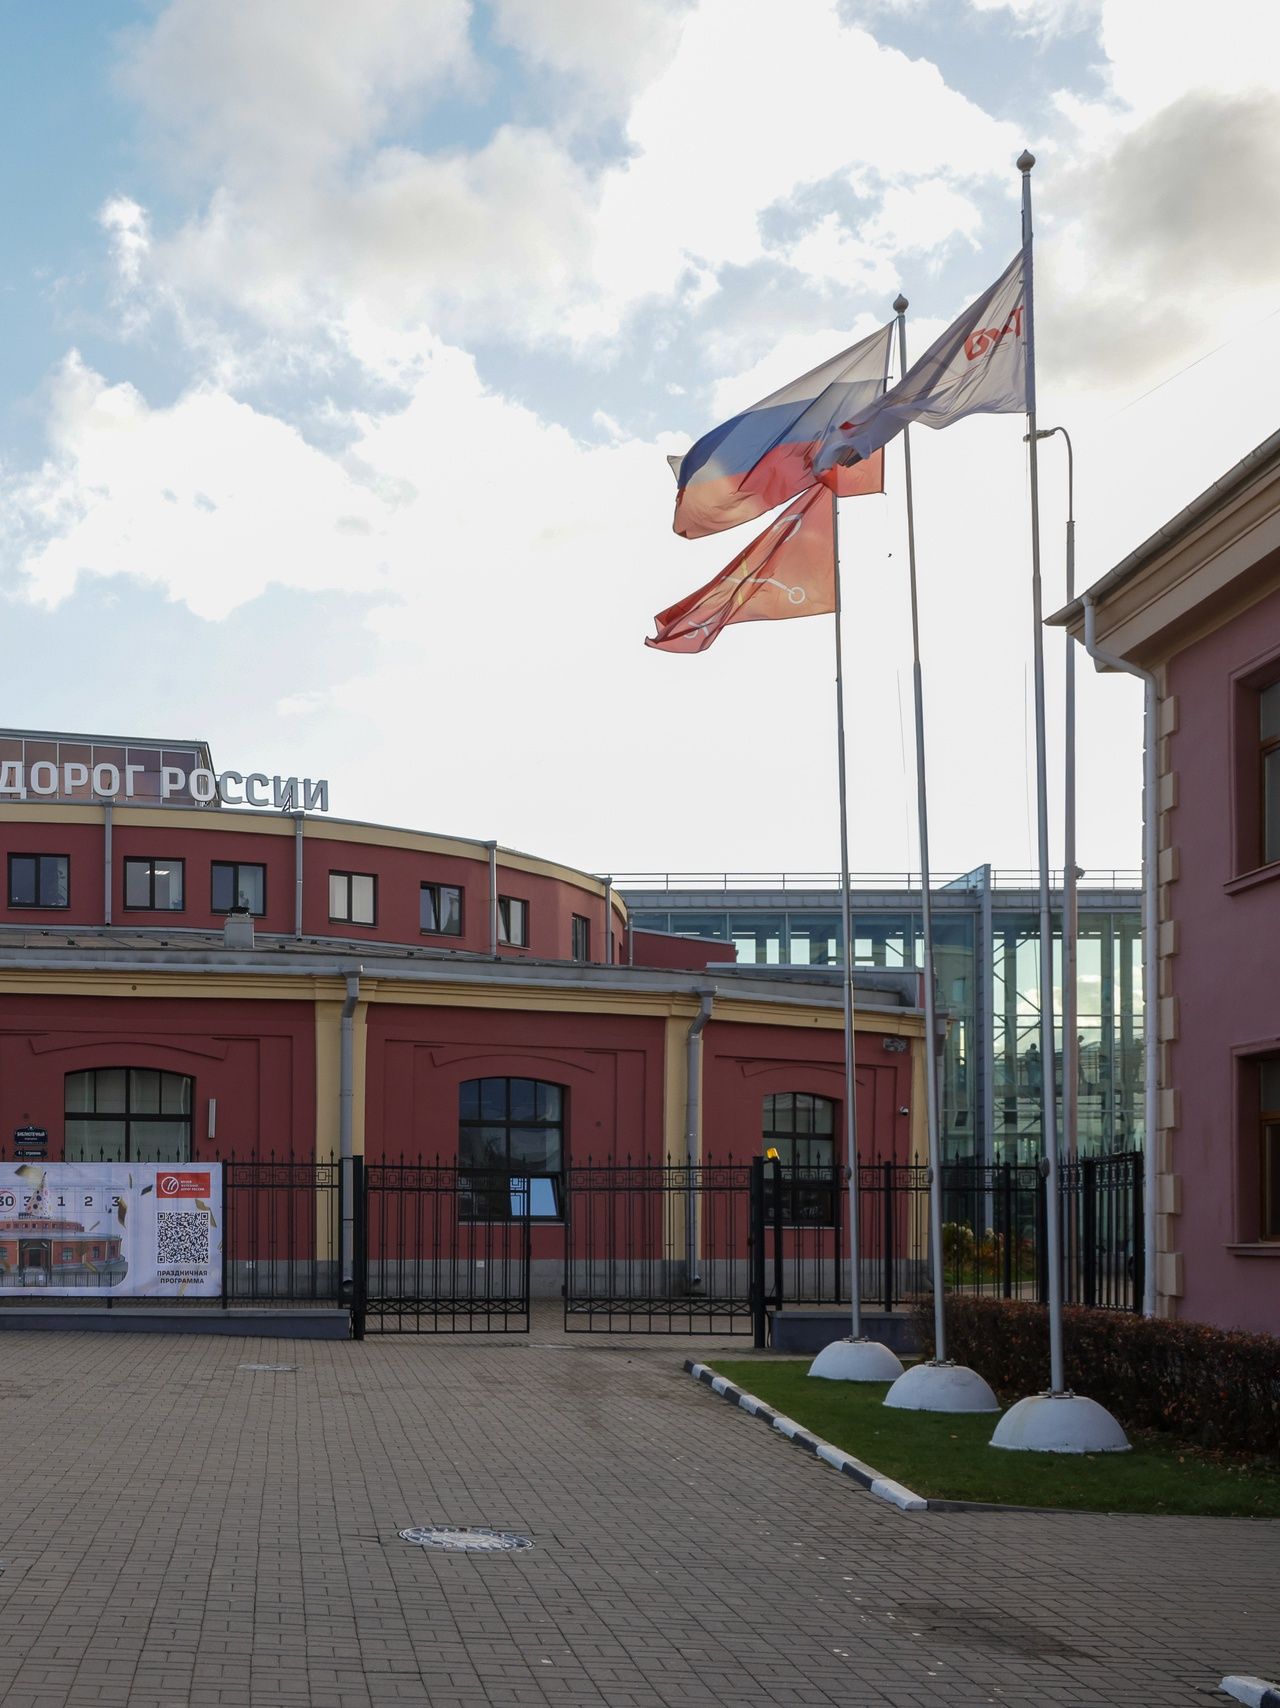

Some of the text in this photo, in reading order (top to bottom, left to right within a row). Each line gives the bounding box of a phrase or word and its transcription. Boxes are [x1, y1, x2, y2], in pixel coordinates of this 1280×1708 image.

[162, 766, 329, 812] РОССИИ
[57, 1196, 66, 1207] 1
[84, 1196, 94, 1207] 2
[111, 1196, 121, 1207] 3
